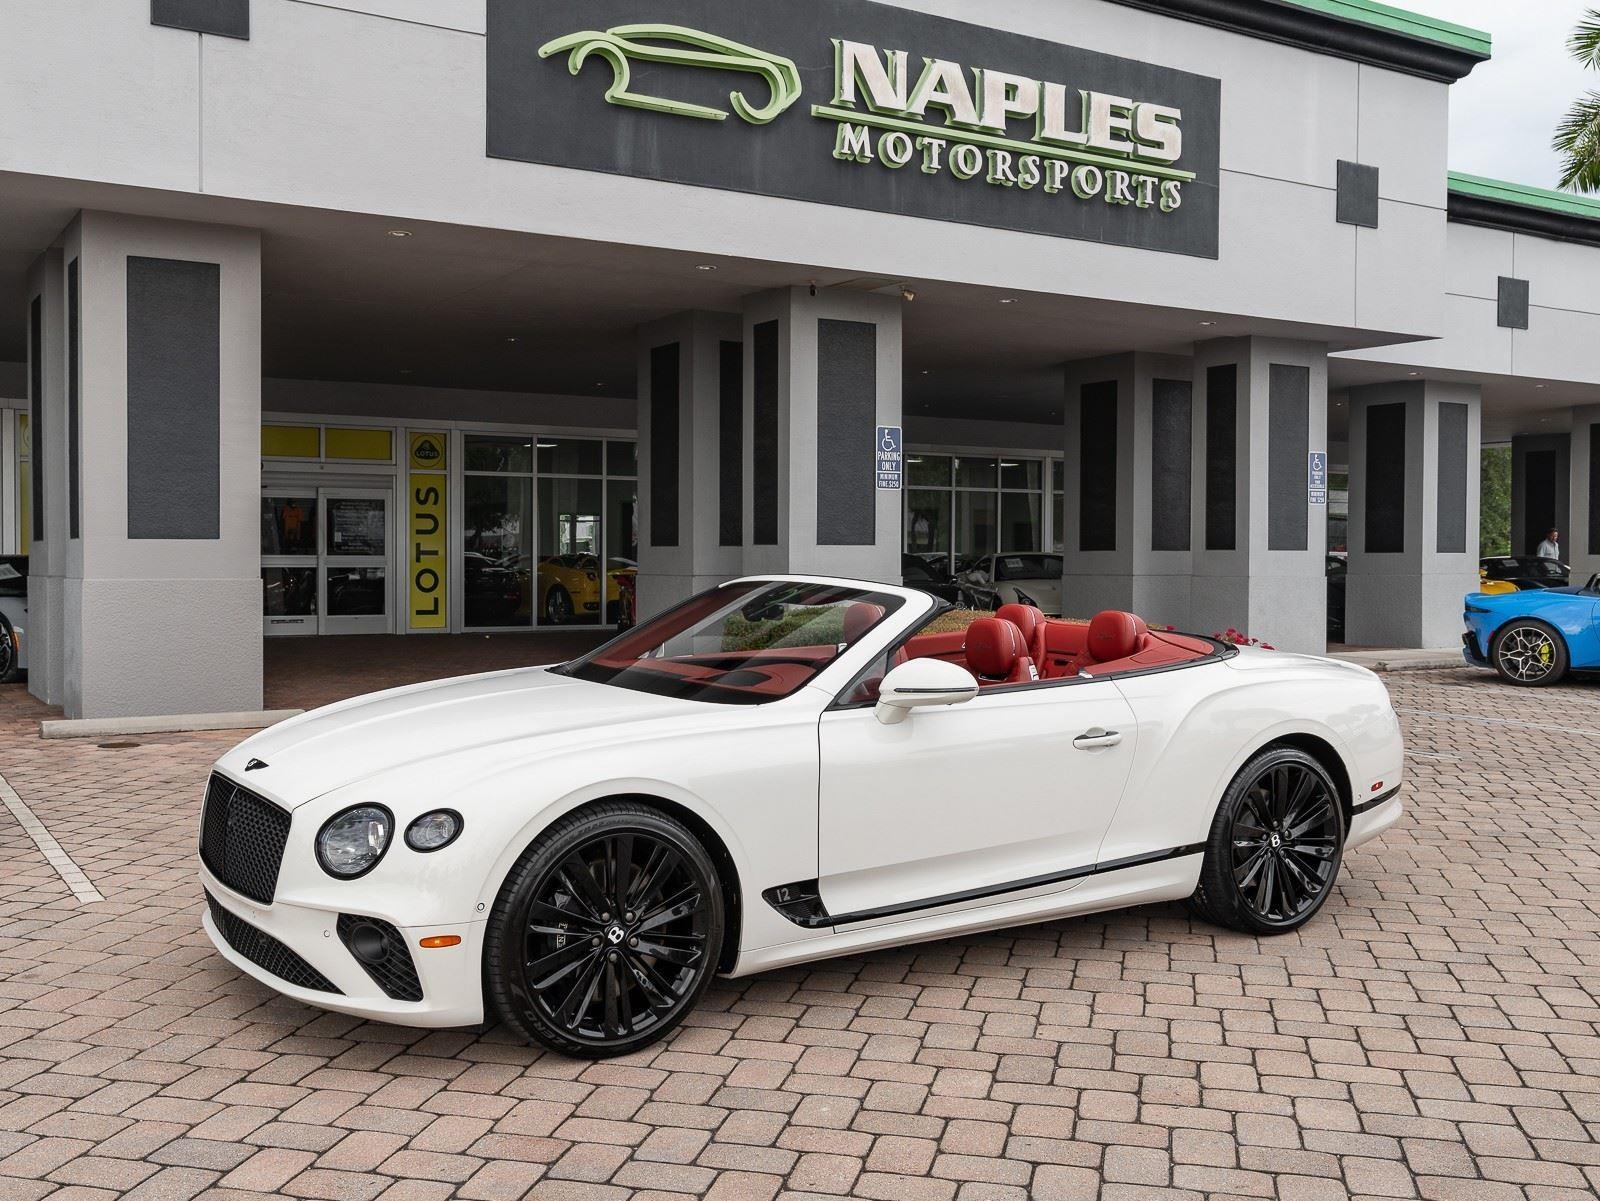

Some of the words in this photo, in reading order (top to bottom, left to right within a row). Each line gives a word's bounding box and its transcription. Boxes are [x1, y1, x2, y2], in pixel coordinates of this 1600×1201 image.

[830, 38, 1182, 165] NAPLES
[832, 122, 1182, 212] MOTORSPORTS
[416, 449, 438, 457] LOTUS
[877, 451, 901, 461] PARKING
[881, 461, 897, 471] ONLY
[415, 486, 439, 616] LOTUS
[1271, 834, 1281, 847] B
[777, 887, 791, 902] 12
[607, 926, 625, 944] B
